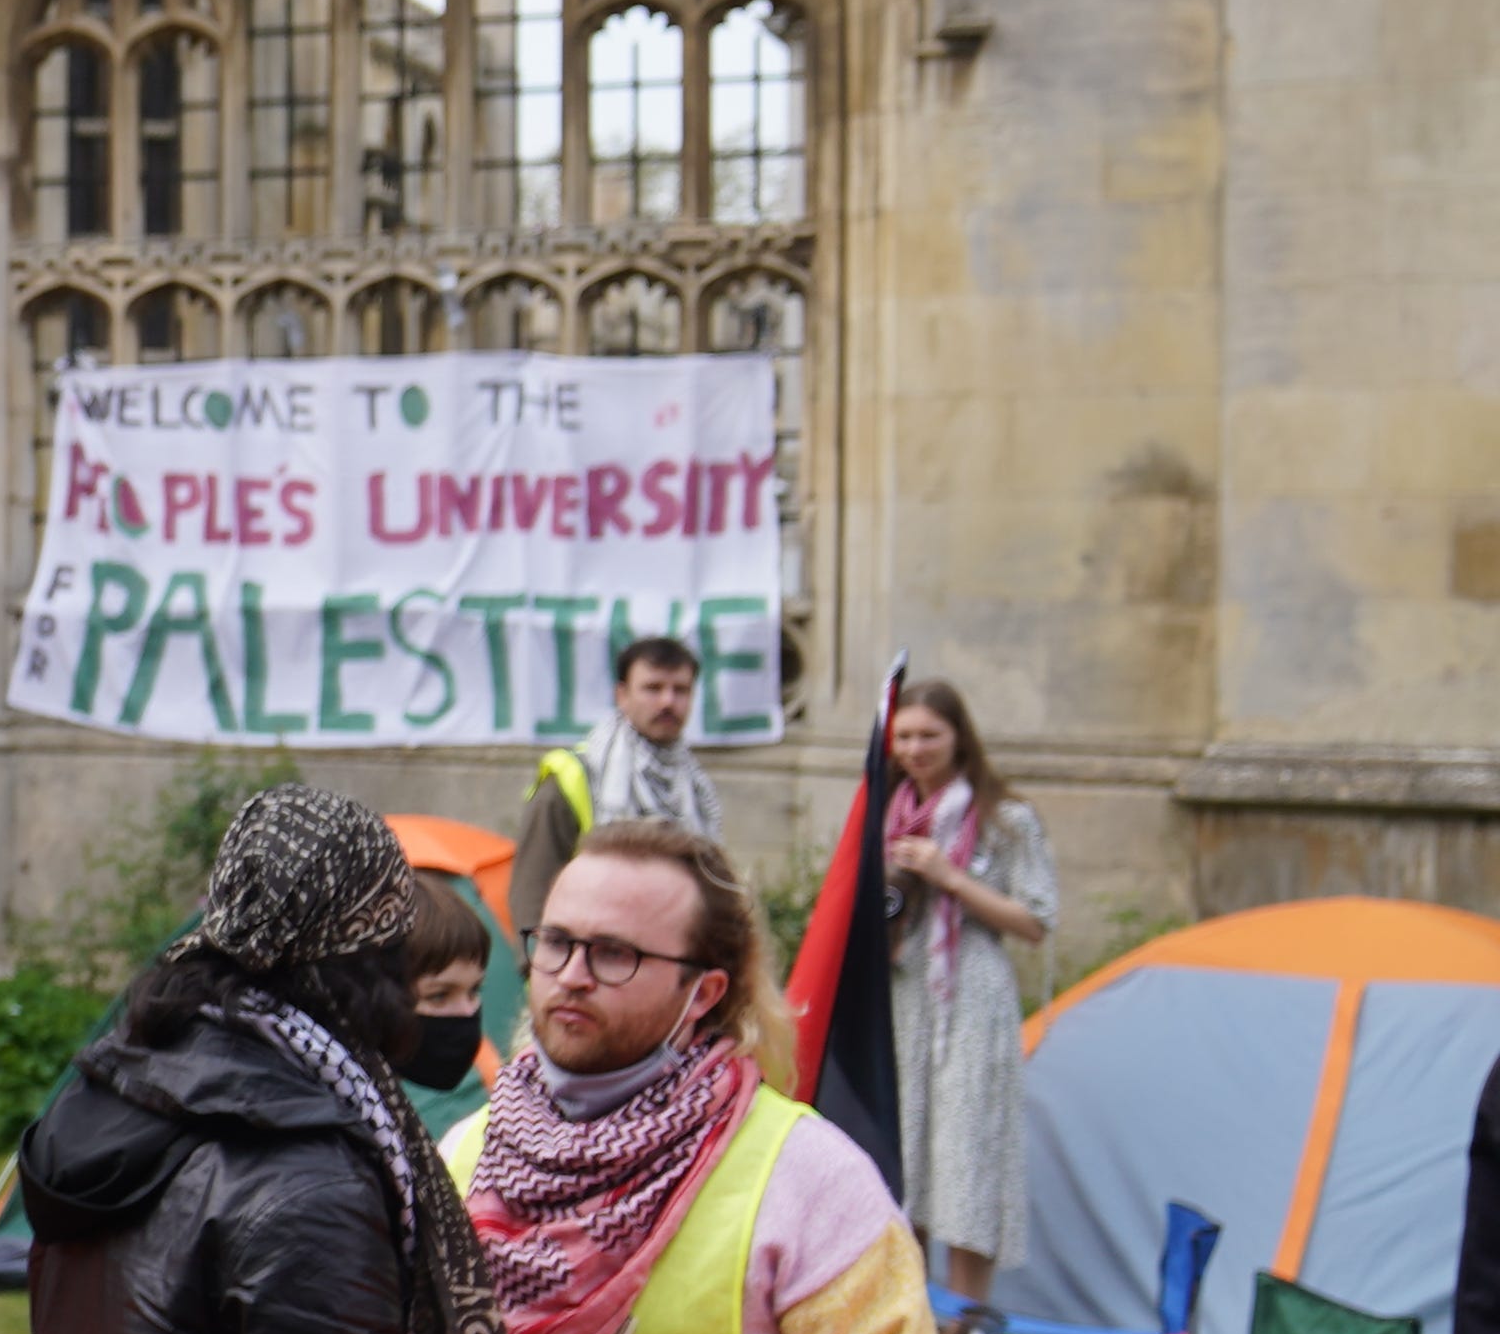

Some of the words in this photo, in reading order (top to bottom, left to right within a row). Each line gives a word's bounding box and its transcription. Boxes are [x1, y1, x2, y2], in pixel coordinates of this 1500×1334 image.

[73, 381, 317, 433] WELCOME
[353, 383, 429, 429] TO
[479, 378, 582, 431] THE
[367, 451, 776, 545] UNIVERSITY
[70, 559, 771, 737] PALESTINE
